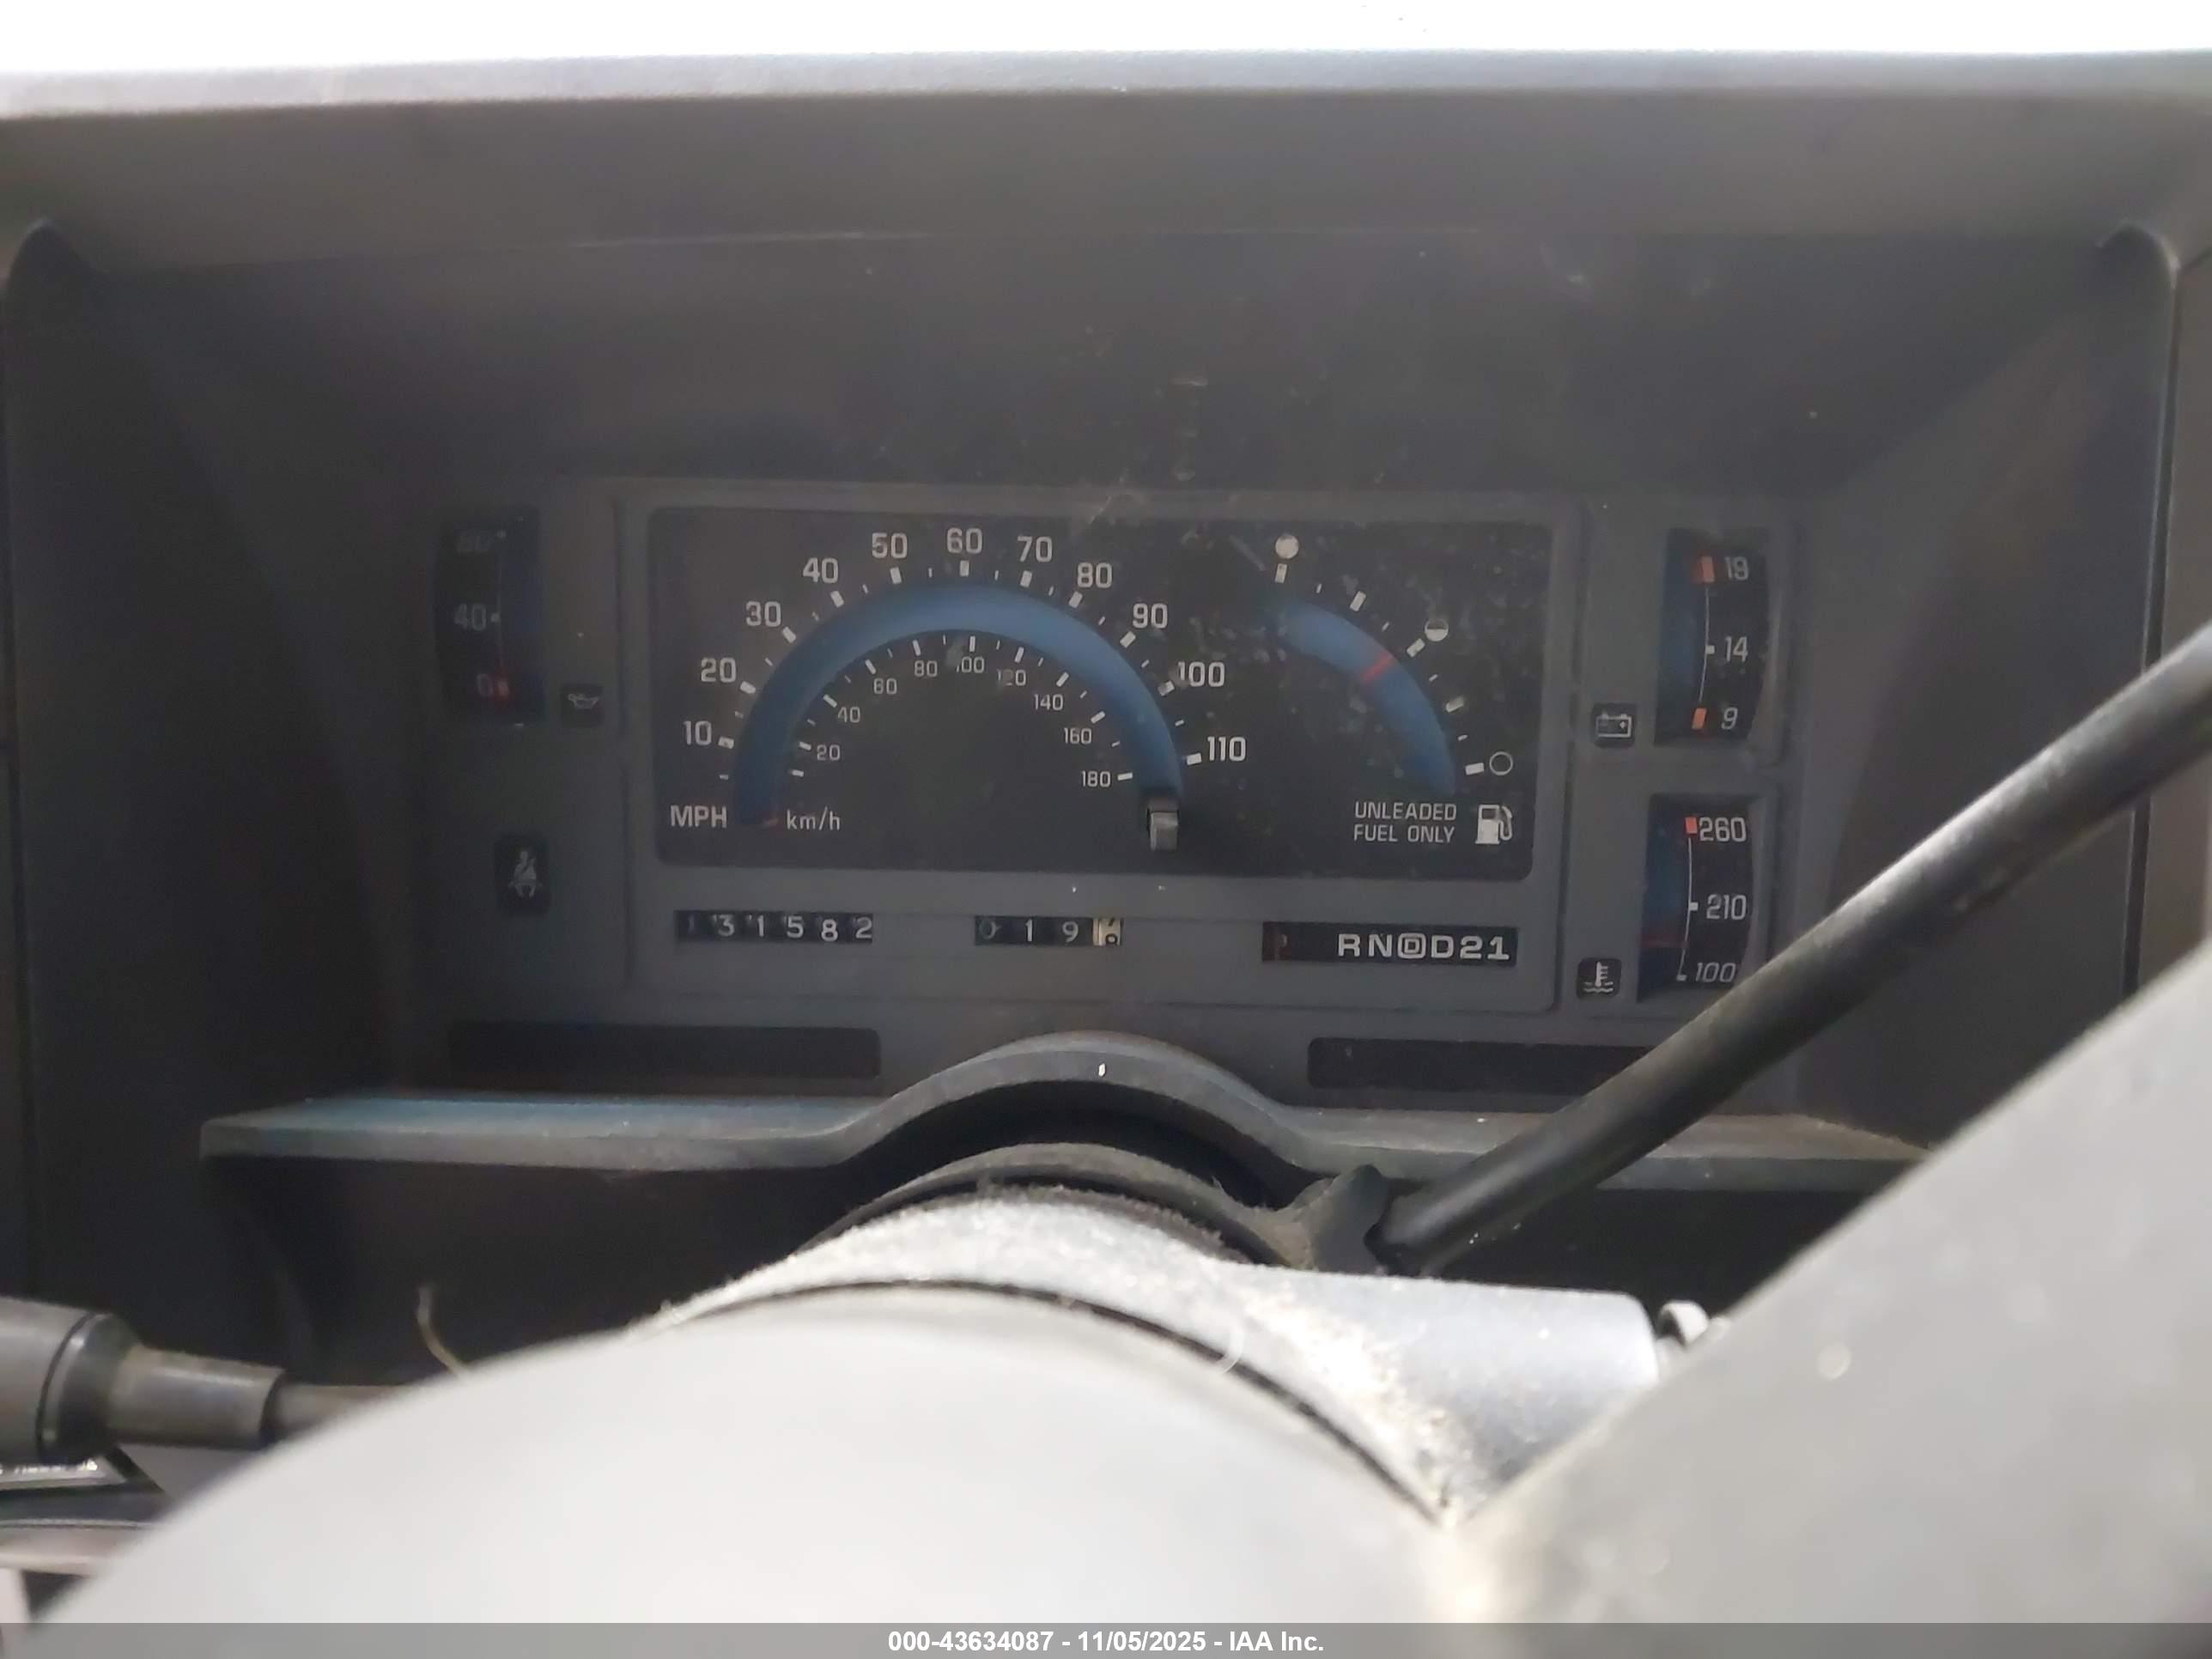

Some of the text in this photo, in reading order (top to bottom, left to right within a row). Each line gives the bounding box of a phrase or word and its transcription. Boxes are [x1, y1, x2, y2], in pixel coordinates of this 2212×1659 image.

[872, 532, 908, 559] 50
[947, 527, 982, 554] 60
[1017, 536, 1053, 562] 70
[803, 556, 839, 583] 40
[1078, 562, 1113, 588] 80
[1724, 556, 1749, 580] 19
[453, 603, 487, 631] 40
[746, 600, 781, 627] 30
[1133, 603, 1168, 629] 90
[1725, 635, 1748, 662] 14
[701, 657, 737, 683] 20
[915, 660, 938, 677] 80
[1177, 661, 1225, 687] 100
[1034, 693, 1064, 710] 140
[837, 706, 860, 723] 40
[1721, 707, 1738, 730] 9
[684, 720, 712, 745] 10
[1064, 727, 1092, 744] 160
[817, 744, 841, 761] 20
[1207, 736, 1246, 762] 110
[1082, 770, 1111, 787] 180
[670, 805, 727, 828] MPH
[787, 805, 841, 830] km/h
[1354, 801, 1457, 821] UNLEADED
[1353, 823, 1455, 843] FUEL ONLY
[1698, 817, 1747, 842] 260
[1706, 894, 1747, 920] 210
[1695, 962, 1736, 982] 100
